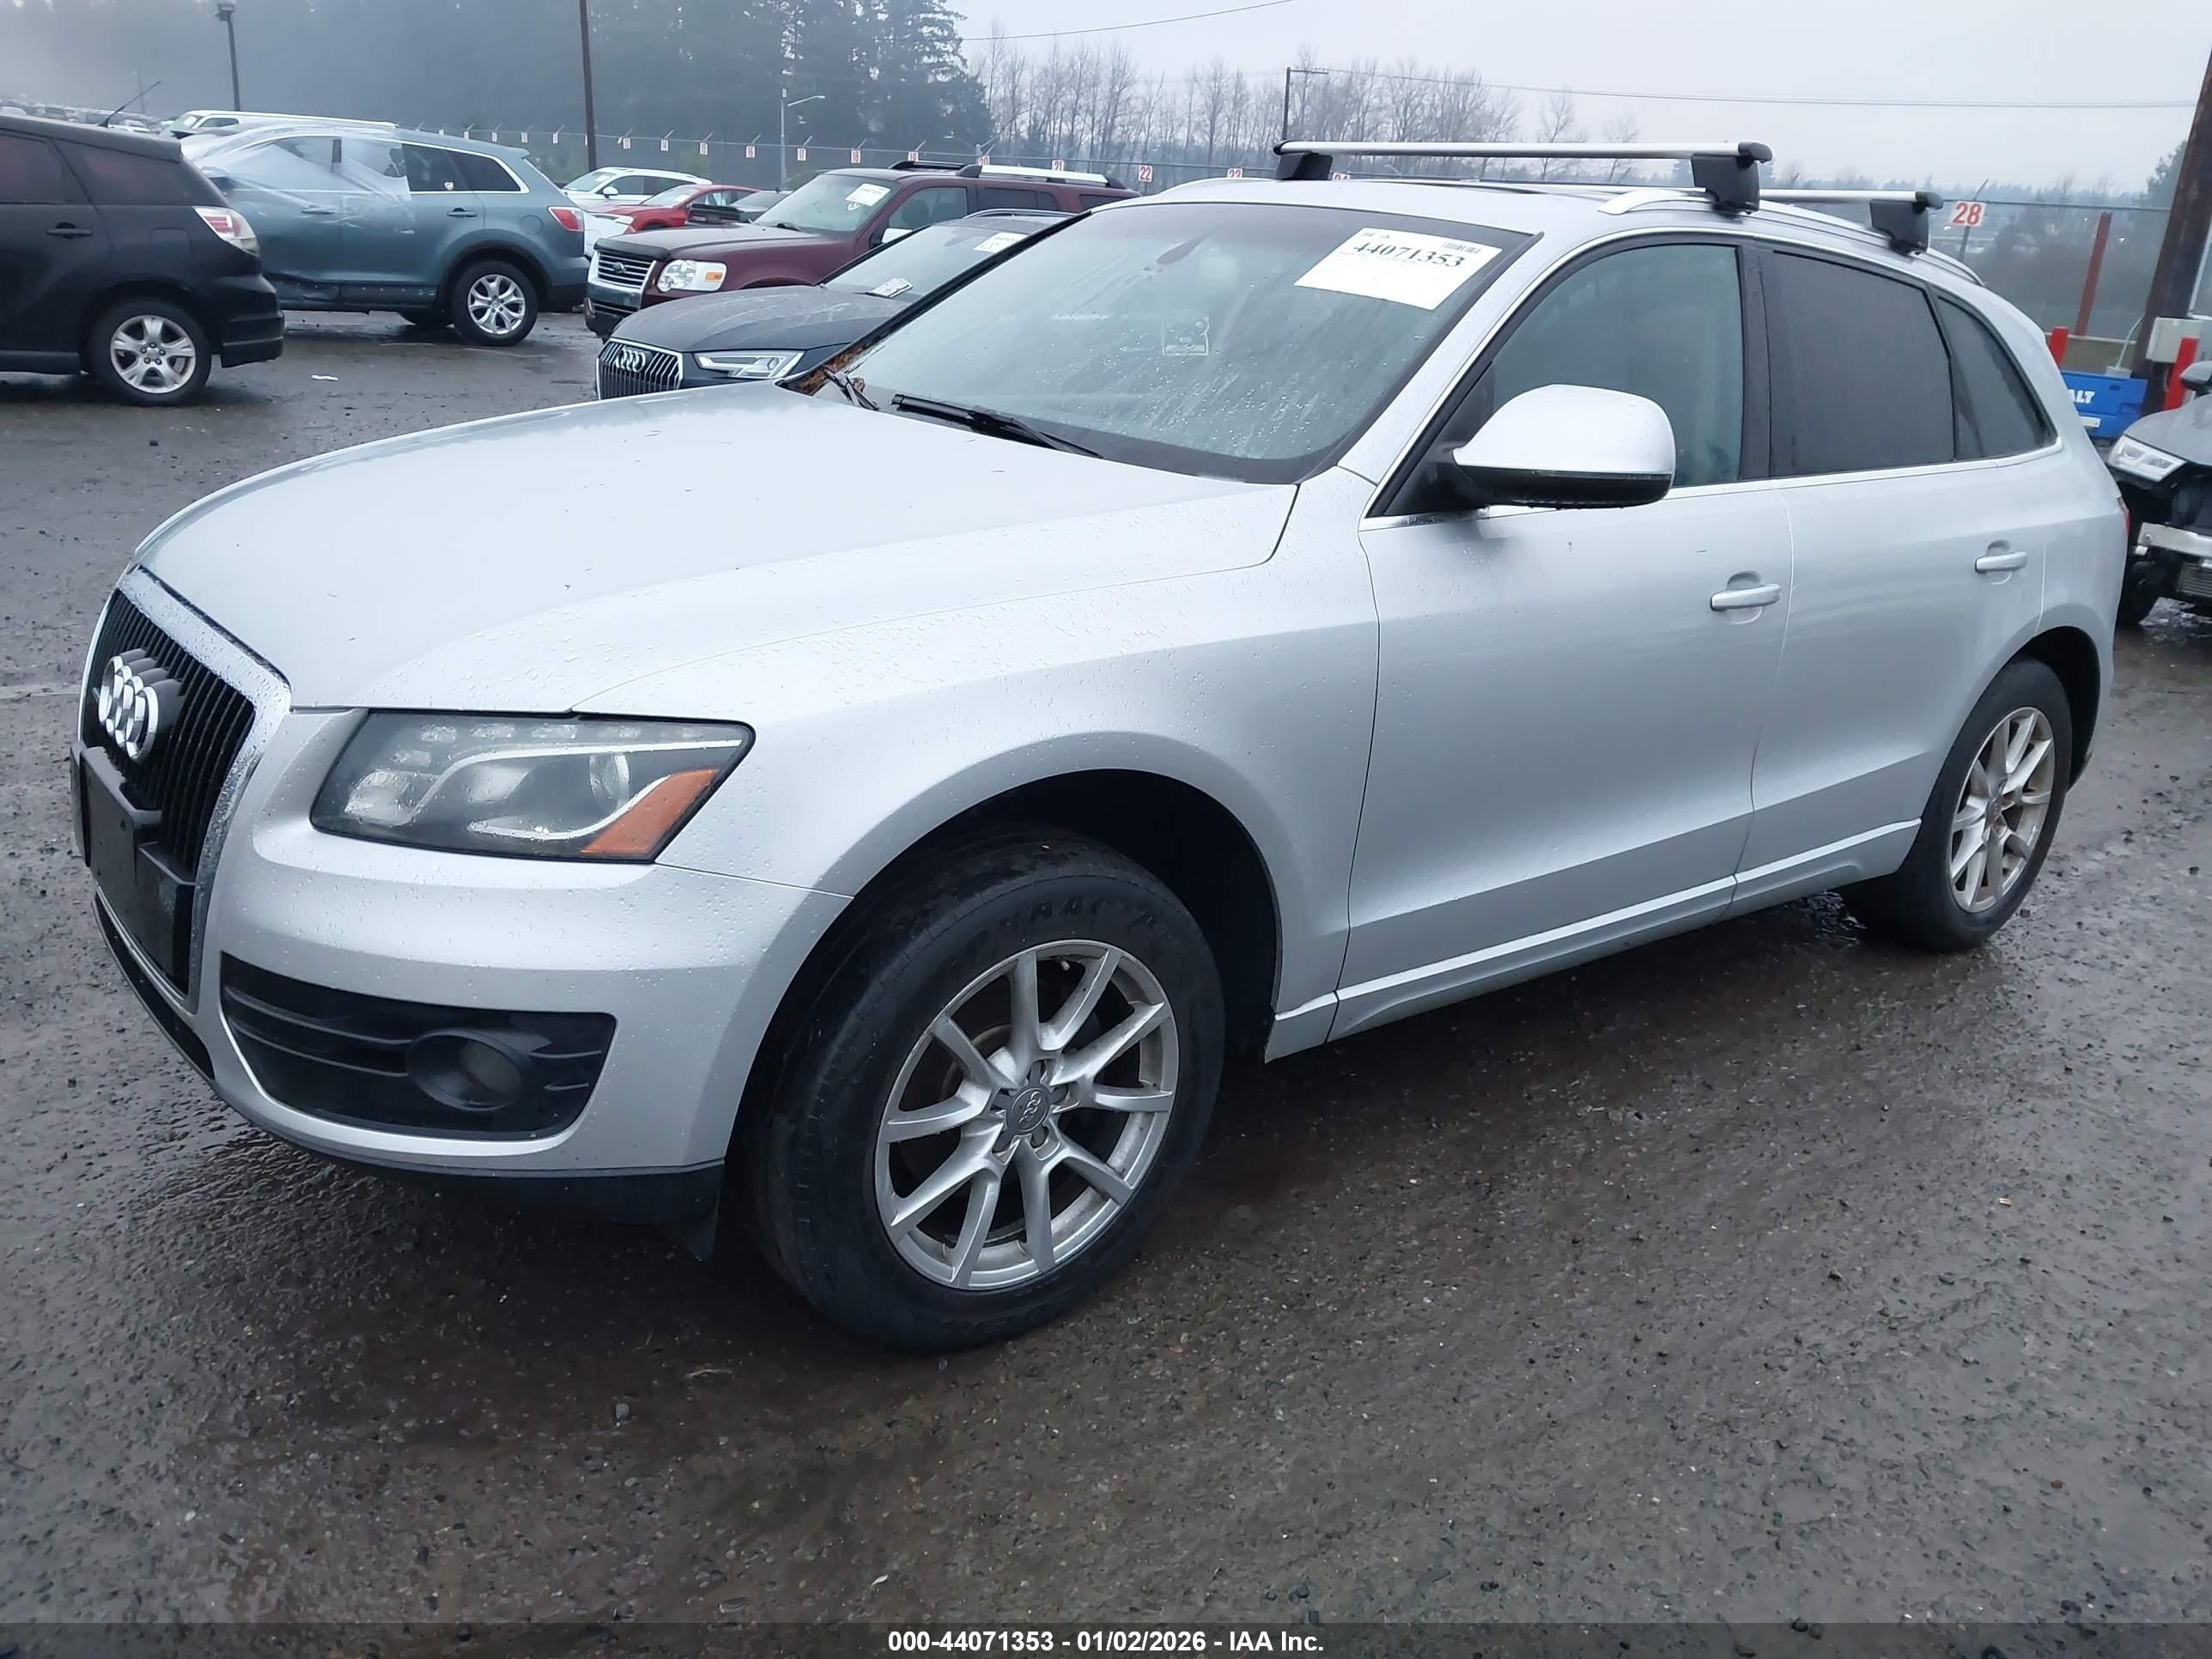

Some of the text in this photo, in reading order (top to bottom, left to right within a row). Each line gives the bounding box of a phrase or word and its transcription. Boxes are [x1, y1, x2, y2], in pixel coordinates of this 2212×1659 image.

[1139, 167, 1151, 180] 22
[1953, 203, 1982, 225] 28
[1353, 242, 1466, 268] 44071353
